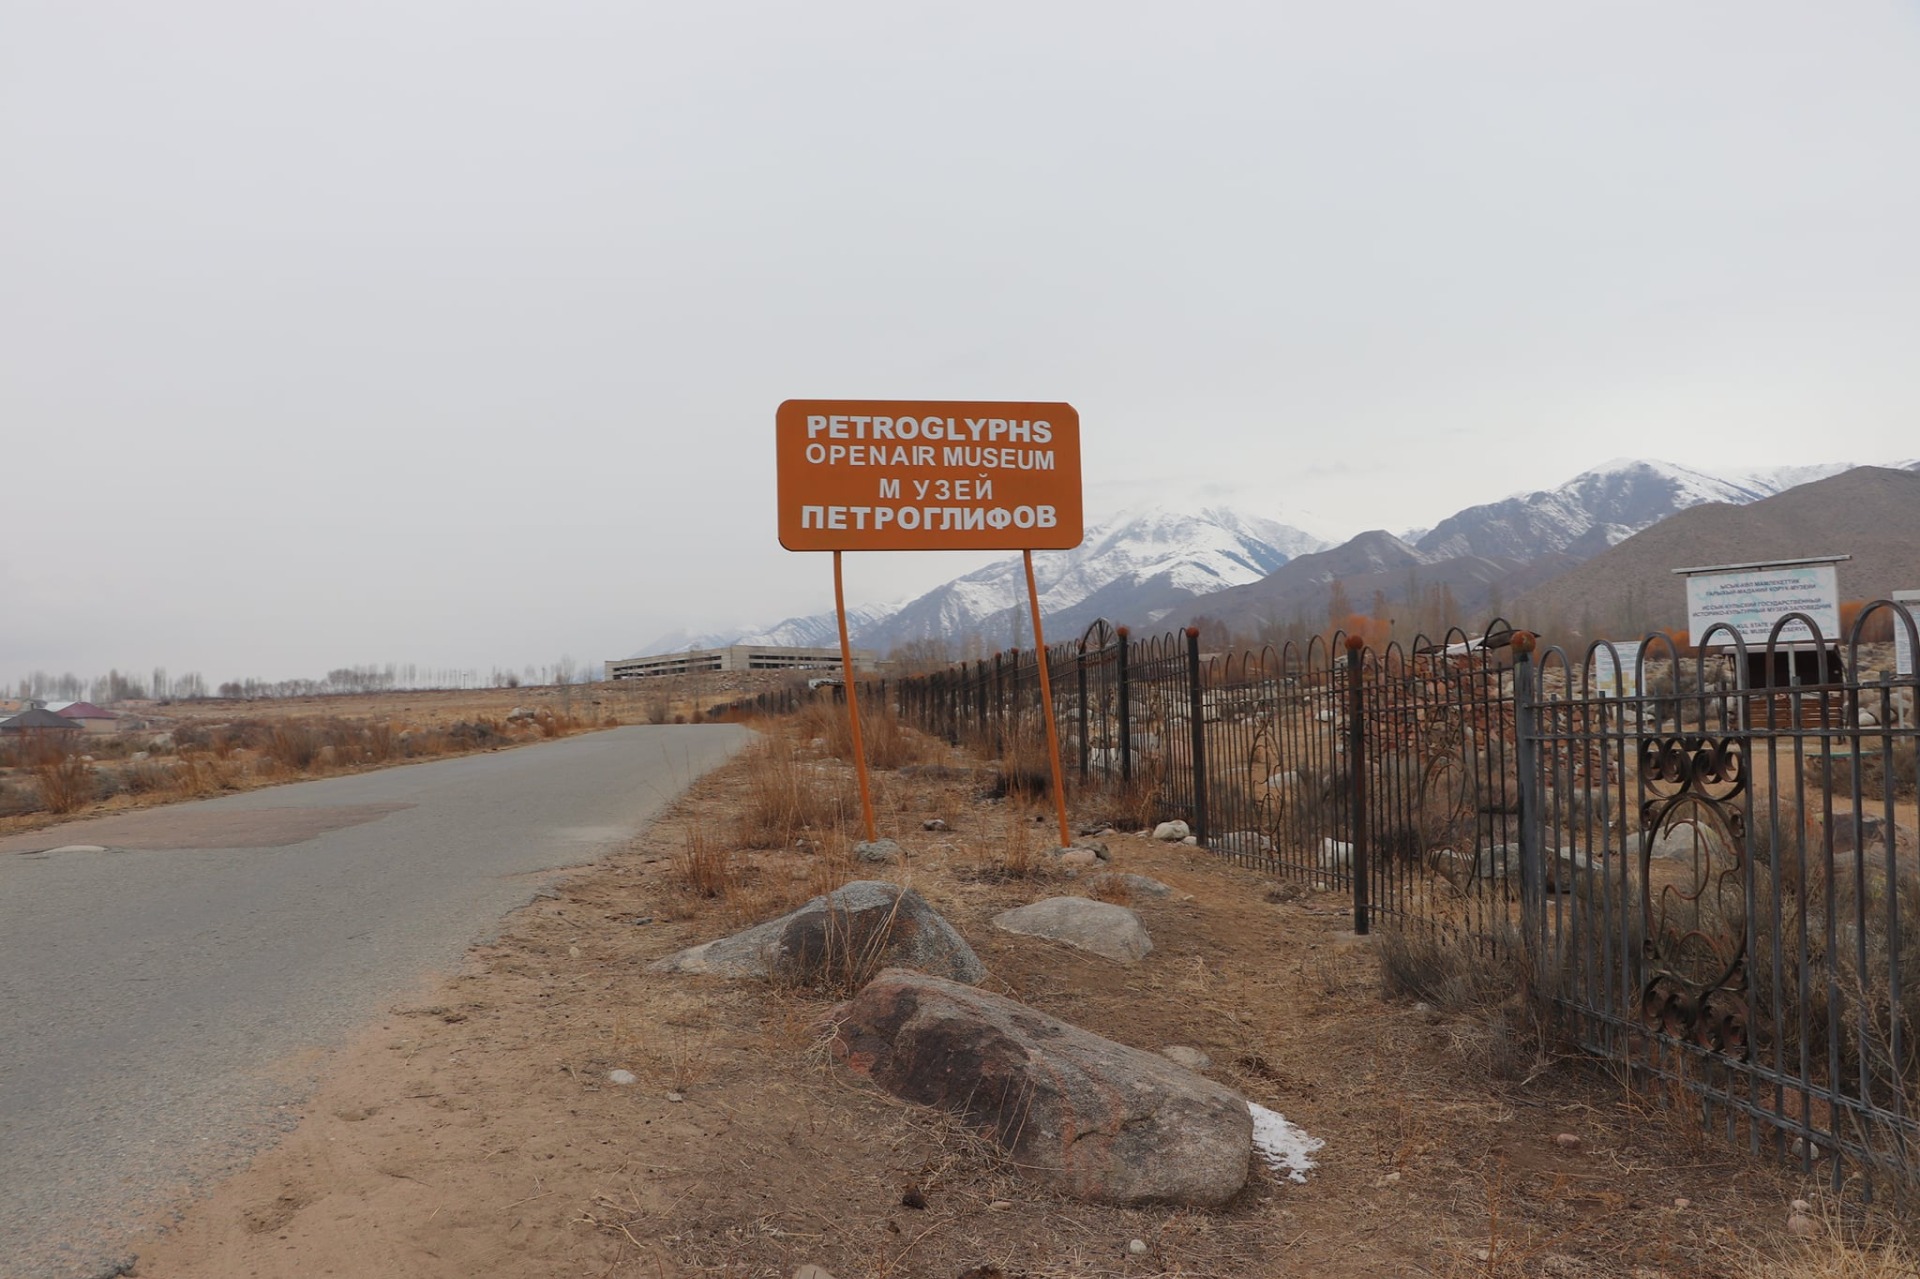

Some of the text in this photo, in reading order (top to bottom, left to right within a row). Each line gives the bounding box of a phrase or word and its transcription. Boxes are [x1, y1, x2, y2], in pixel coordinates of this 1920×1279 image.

[806, 415, 1053, 444] PETROGLYPHS
[943, 446, 1055, 471] MUSEUM
[801, 505, 1057, 530] ПЕТРОГЛИФОВ
